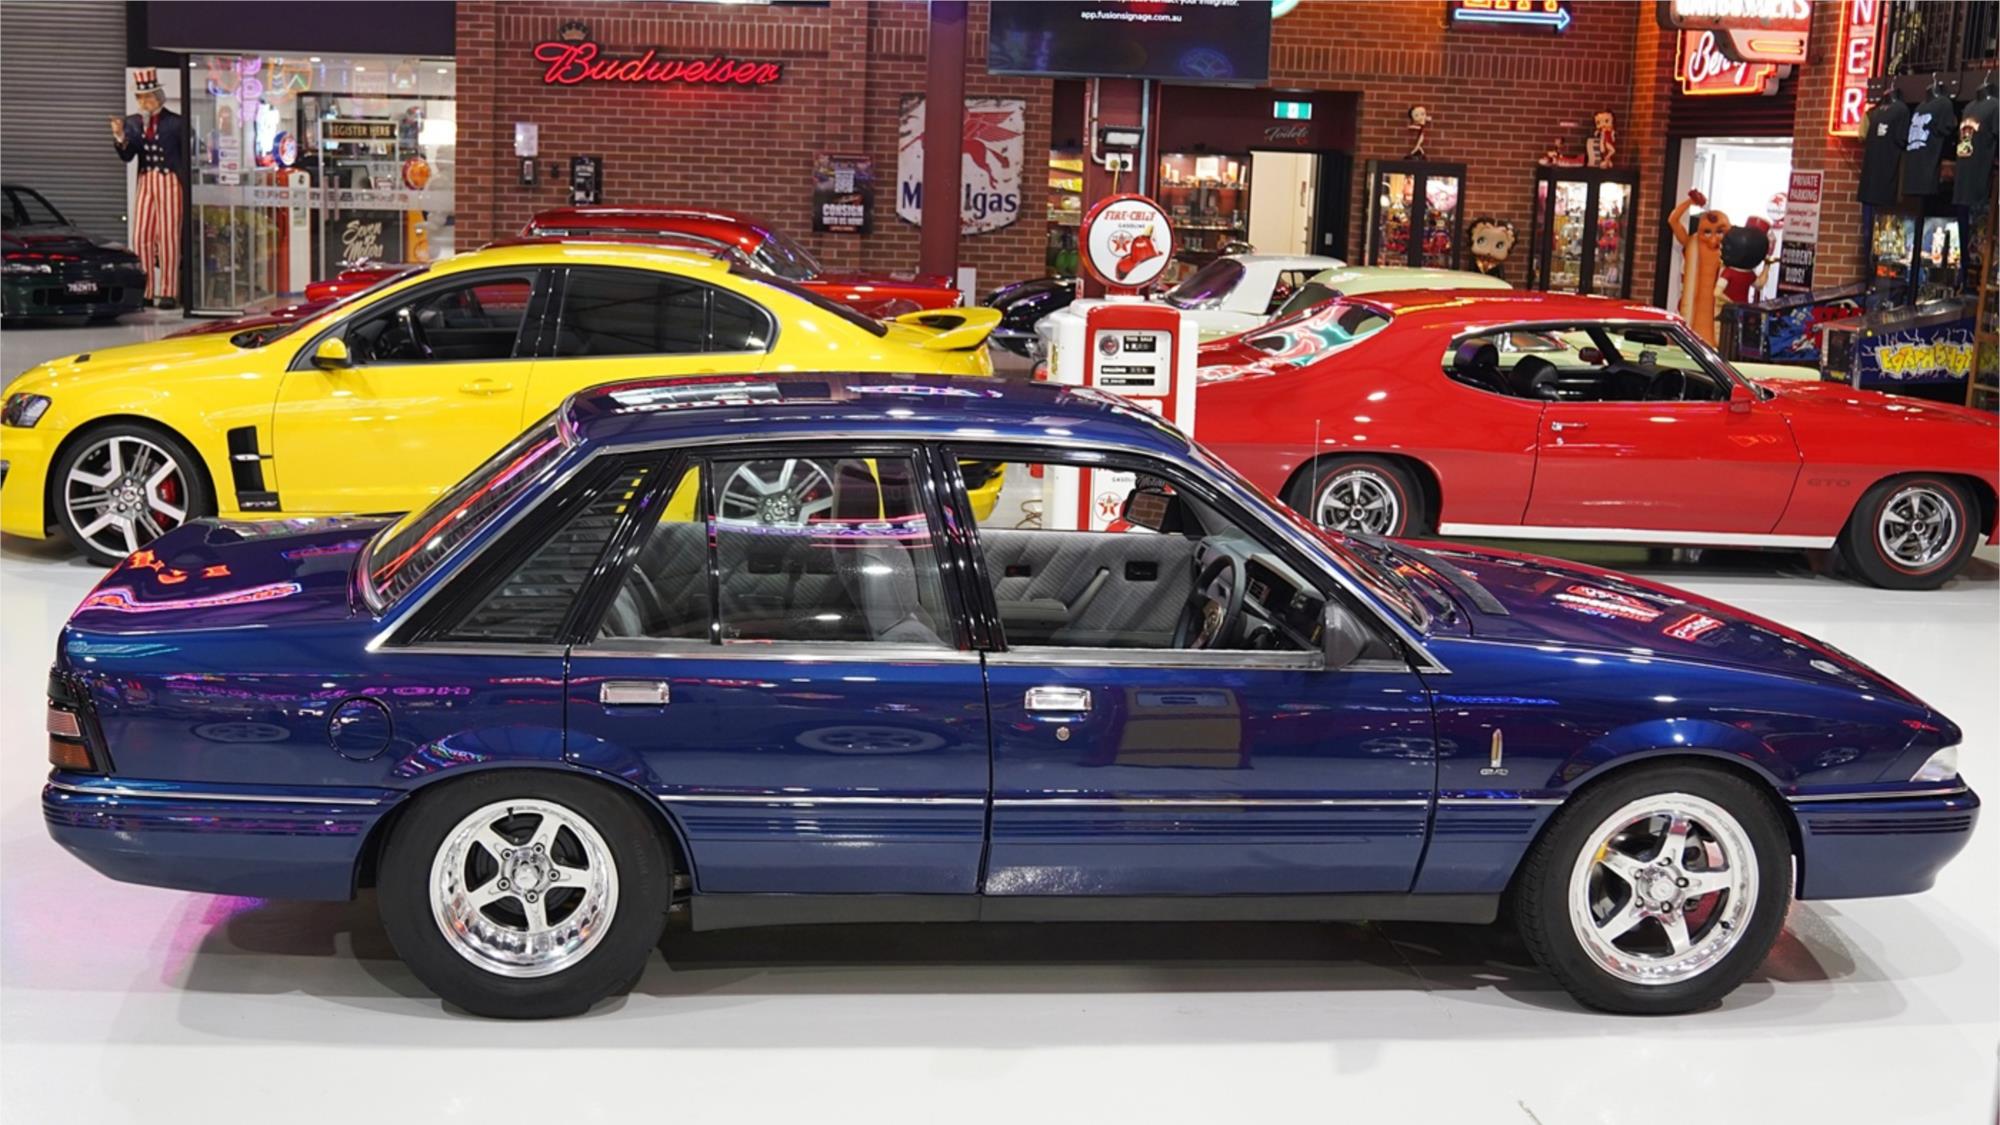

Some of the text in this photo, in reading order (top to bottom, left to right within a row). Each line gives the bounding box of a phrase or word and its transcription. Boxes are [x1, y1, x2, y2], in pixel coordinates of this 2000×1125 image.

[1081, 11, 1182, 22] app.fusionsignage.com.au
[534, 42, 781, 84] Budweiser
[1791, 175, 1819, 187] PRIVATE
[902, 181, 1017, 219] Mlgas
[1789, 189, 1818, 200] PARKING
[822, 204, 864, 216] CONSIGN
[1782, 248, 1812, 265] CURRENT
